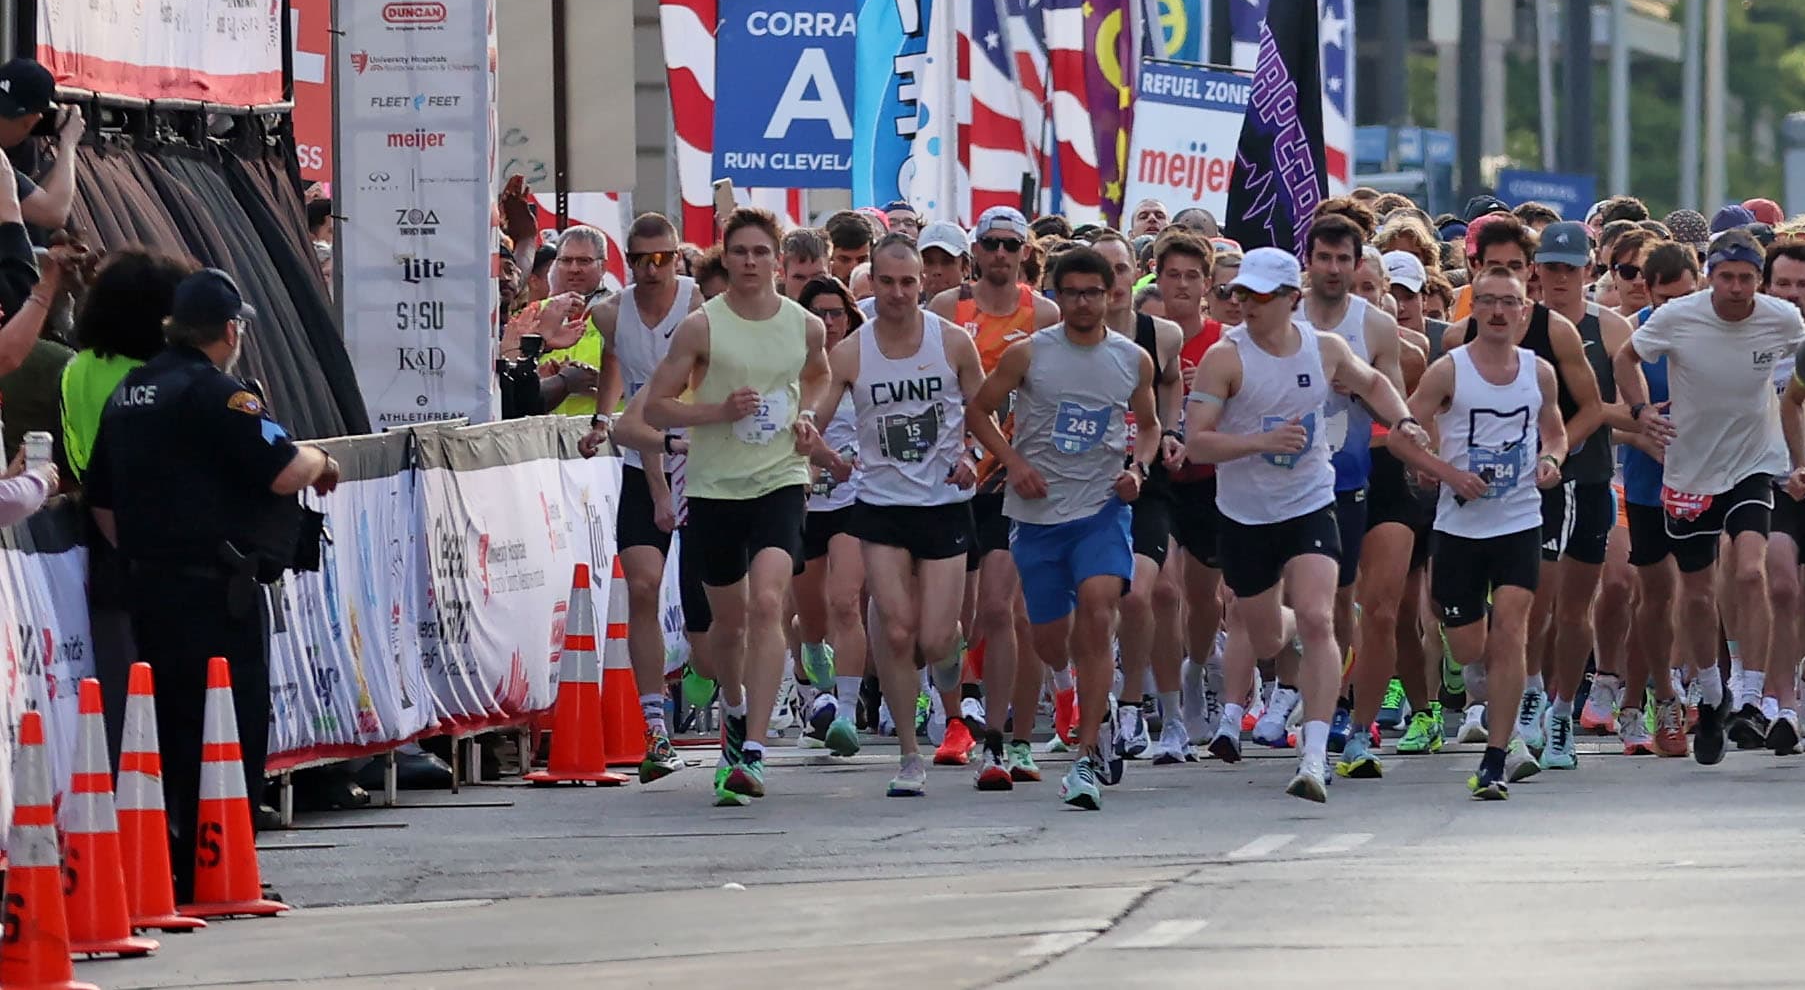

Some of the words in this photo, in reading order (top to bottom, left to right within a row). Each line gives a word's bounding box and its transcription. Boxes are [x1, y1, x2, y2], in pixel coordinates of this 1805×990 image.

[388, 7, 441, 18] DUNCAN
[763, 48, 854, 139] A
[1142, 72, 1202, 99] REFUEL
[1204, 80, 1251, 105] ZONE
[371, 97, 410, 107] FLEET
[428, 96, 460, 106] FEET
[387, 128, 445, 151] meijer
[724, 152, 765, 169] RUN
[402, 257, 445, 284] Lite
[398, 347, 446, 370] K&D
[870, 377, 942, 406] CVNP
[904, 423, 921, 437] 15
[1067, 417, 1097, 435] 243
